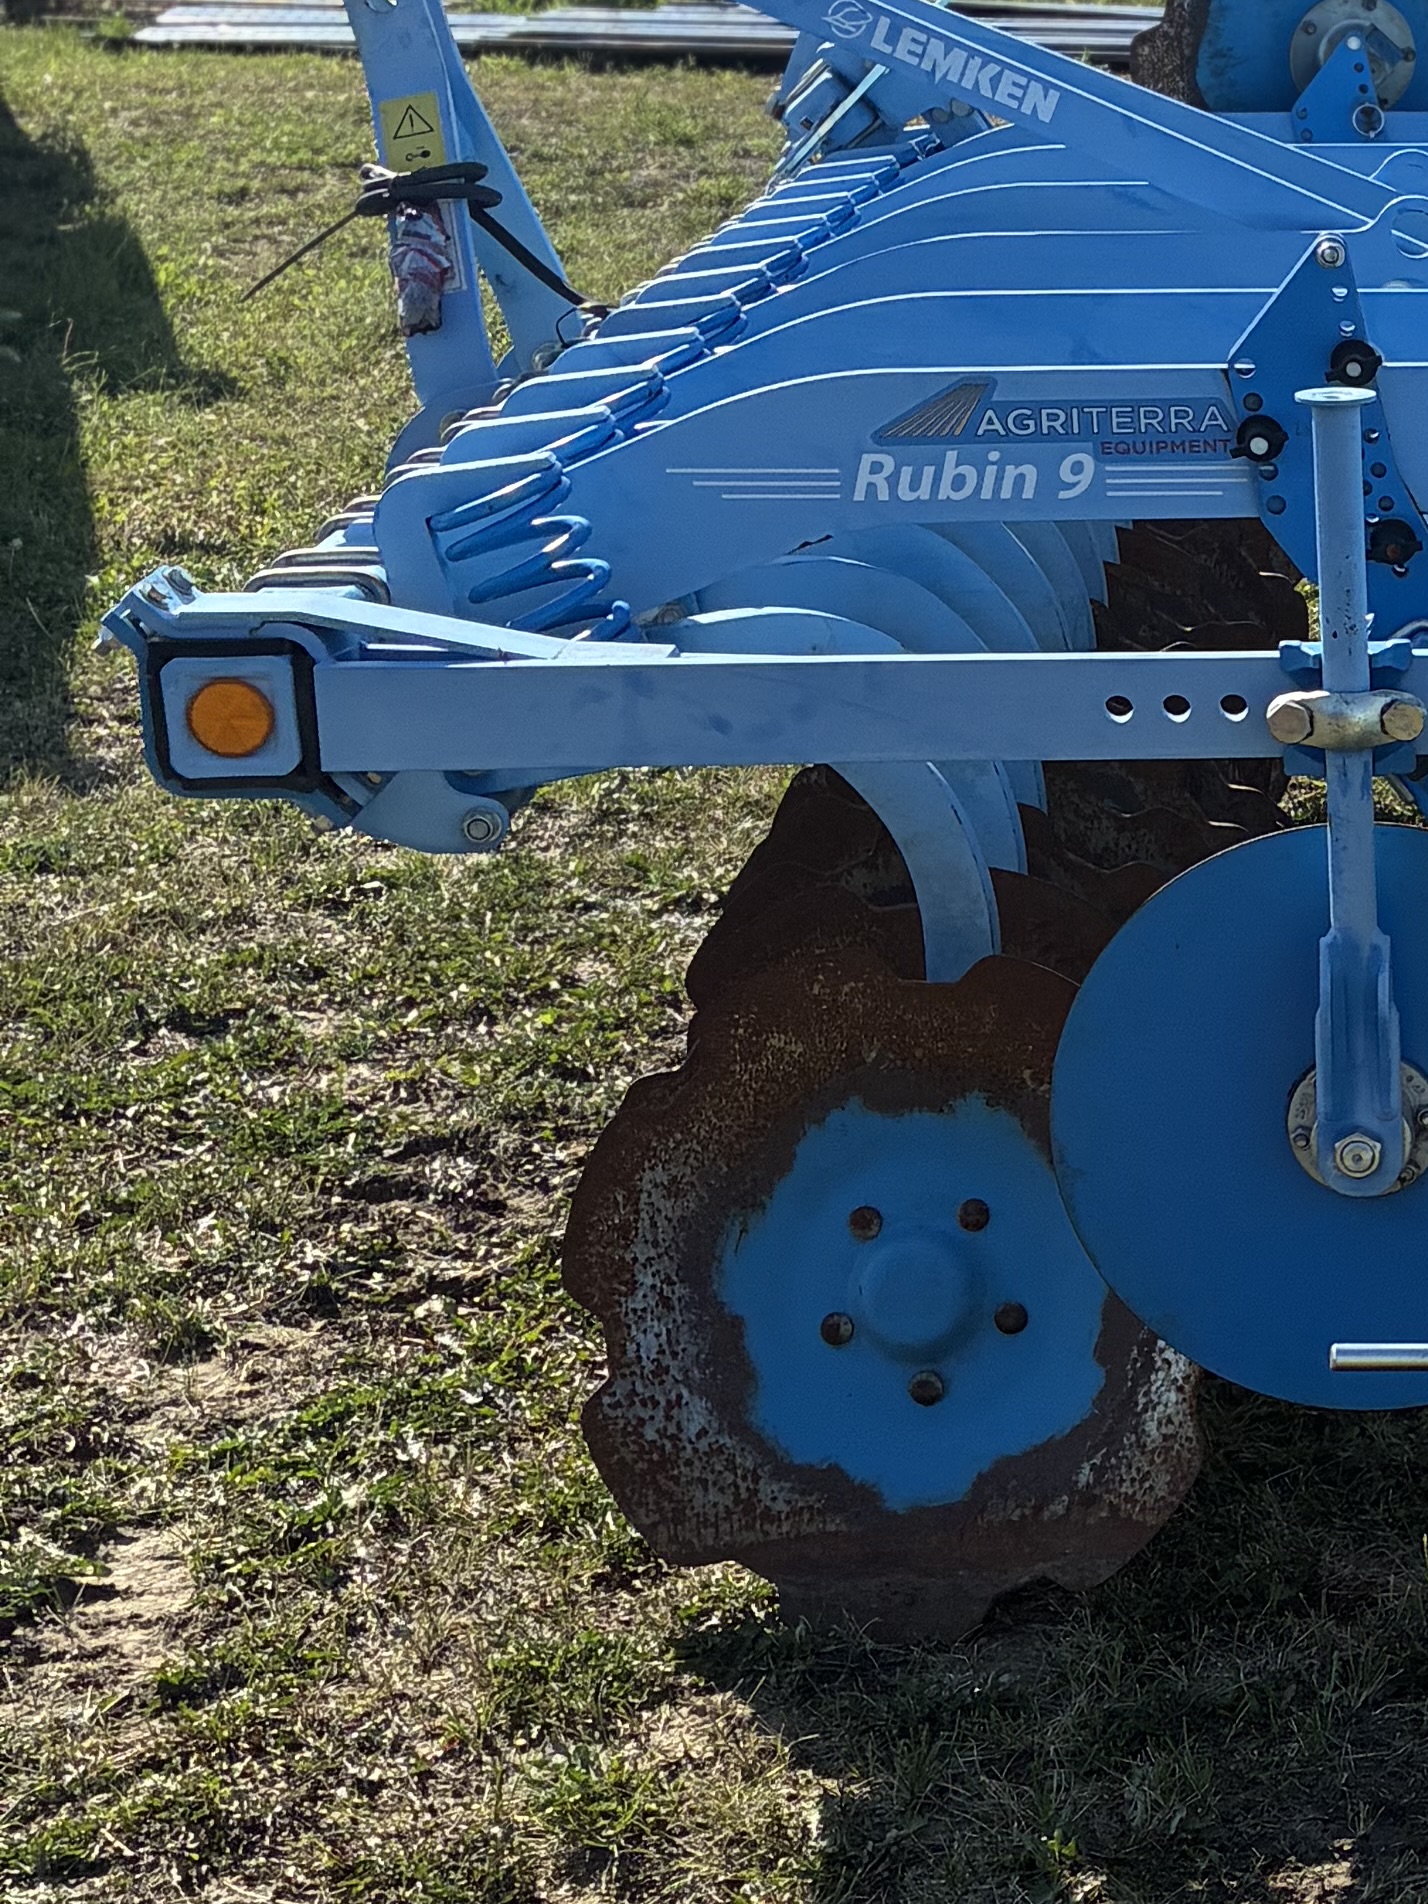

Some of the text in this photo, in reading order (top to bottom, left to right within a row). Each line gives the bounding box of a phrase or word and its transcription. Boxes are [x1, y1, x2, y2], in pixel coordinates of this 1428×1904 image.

[870, 15, 1061, 123] LEMKEN
[975, 404, 1230, 437] AGRITERRA
[1100, 438, 1231, 456] EQUIPMENT
[853, 449, 1096, 501] Rubin 9
